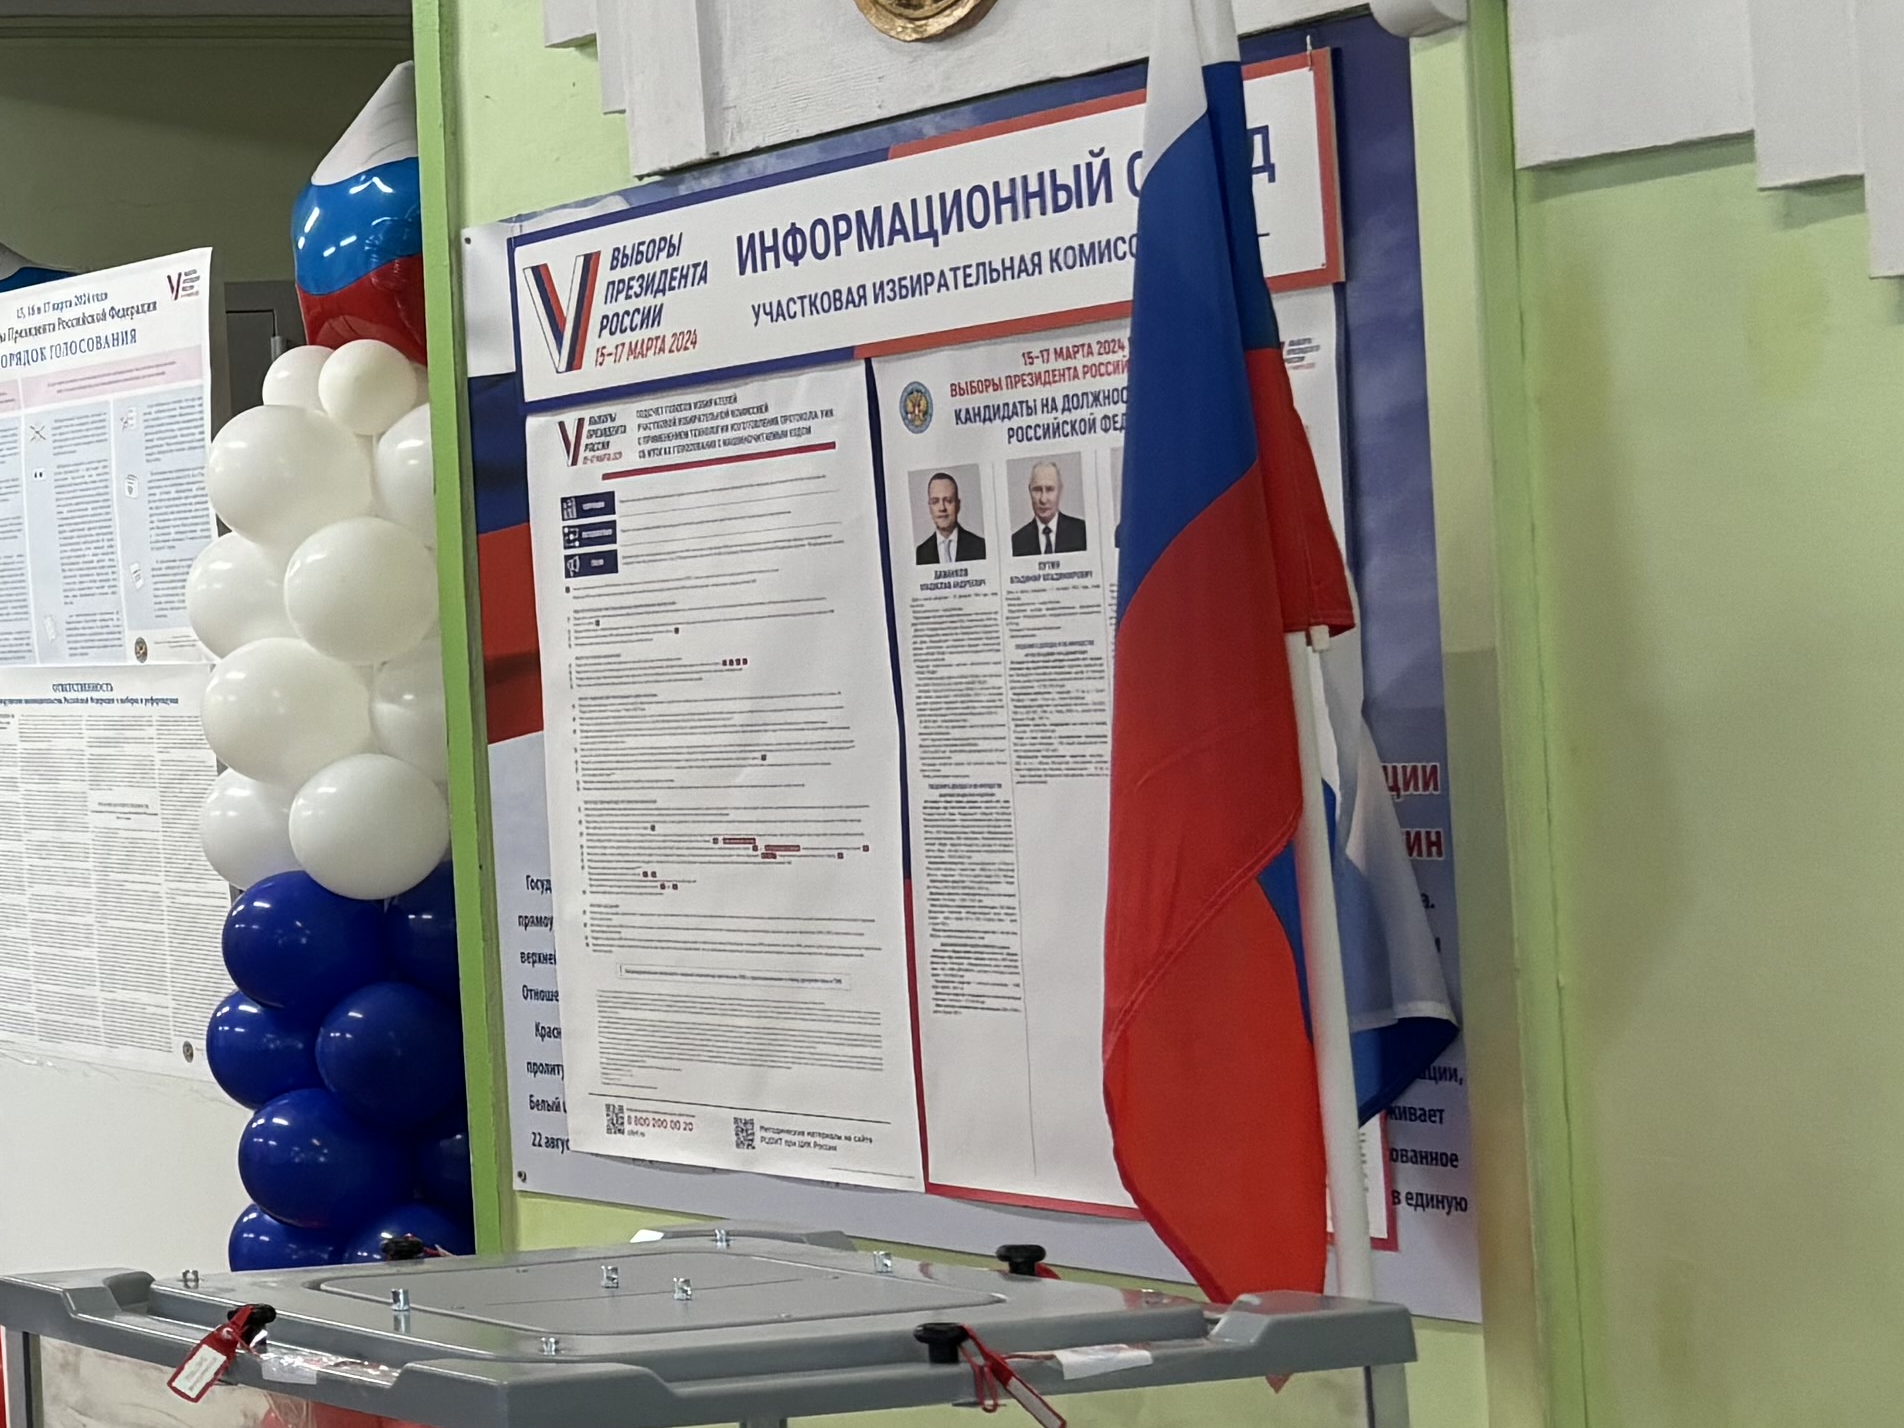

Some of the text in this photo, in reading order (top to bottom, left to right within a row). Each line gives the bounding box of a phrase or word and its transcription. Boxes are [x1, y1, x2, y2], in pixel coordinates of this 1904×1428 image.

[736, 147, 1114, 276] ИНФОРМАЦИОННЫЙ
[610, 232, 683, 271] ВЫБОРЫ
[604, 261, 708, 305] ПРЕЗИДЕНТА
[752, 283, 868, 327] УЧАСТКОВАЯ
[872, 254, 1043, 306] ИЗБИРАТЕЛЬНАЯ
[598, 303, 664, 338] РОССИИ
[50, 328, 137, 358] ГОЛОСОВАНИЯ
[626, 335, 666, 361] МАРТА
[668, 329, 698, 355] 2024
[1054, 342, 1094, 362] МАРТА
[1096, 338, 1125, 356] 2024
[950, 375, 1003, 398] ВЫБОРЫ
[1005, 366, 1080, 392] ПРЕЗИДЕНТА
[954, 399, 1037, 426] КАНДИДАТЫ
[1041, 396, 1058, 416] НА
[1007, 412, 1096, 444] РОССИЙСКОЙ
[1382, 764, 1440, 799] ЦИИ
[1405, 829, 1444, 858] ИН
[522, 984, 559, 1003] Отноше
[1389, 1147, 1459, 1169] ованное
[1405, 1190, 1468, 1216] единую
